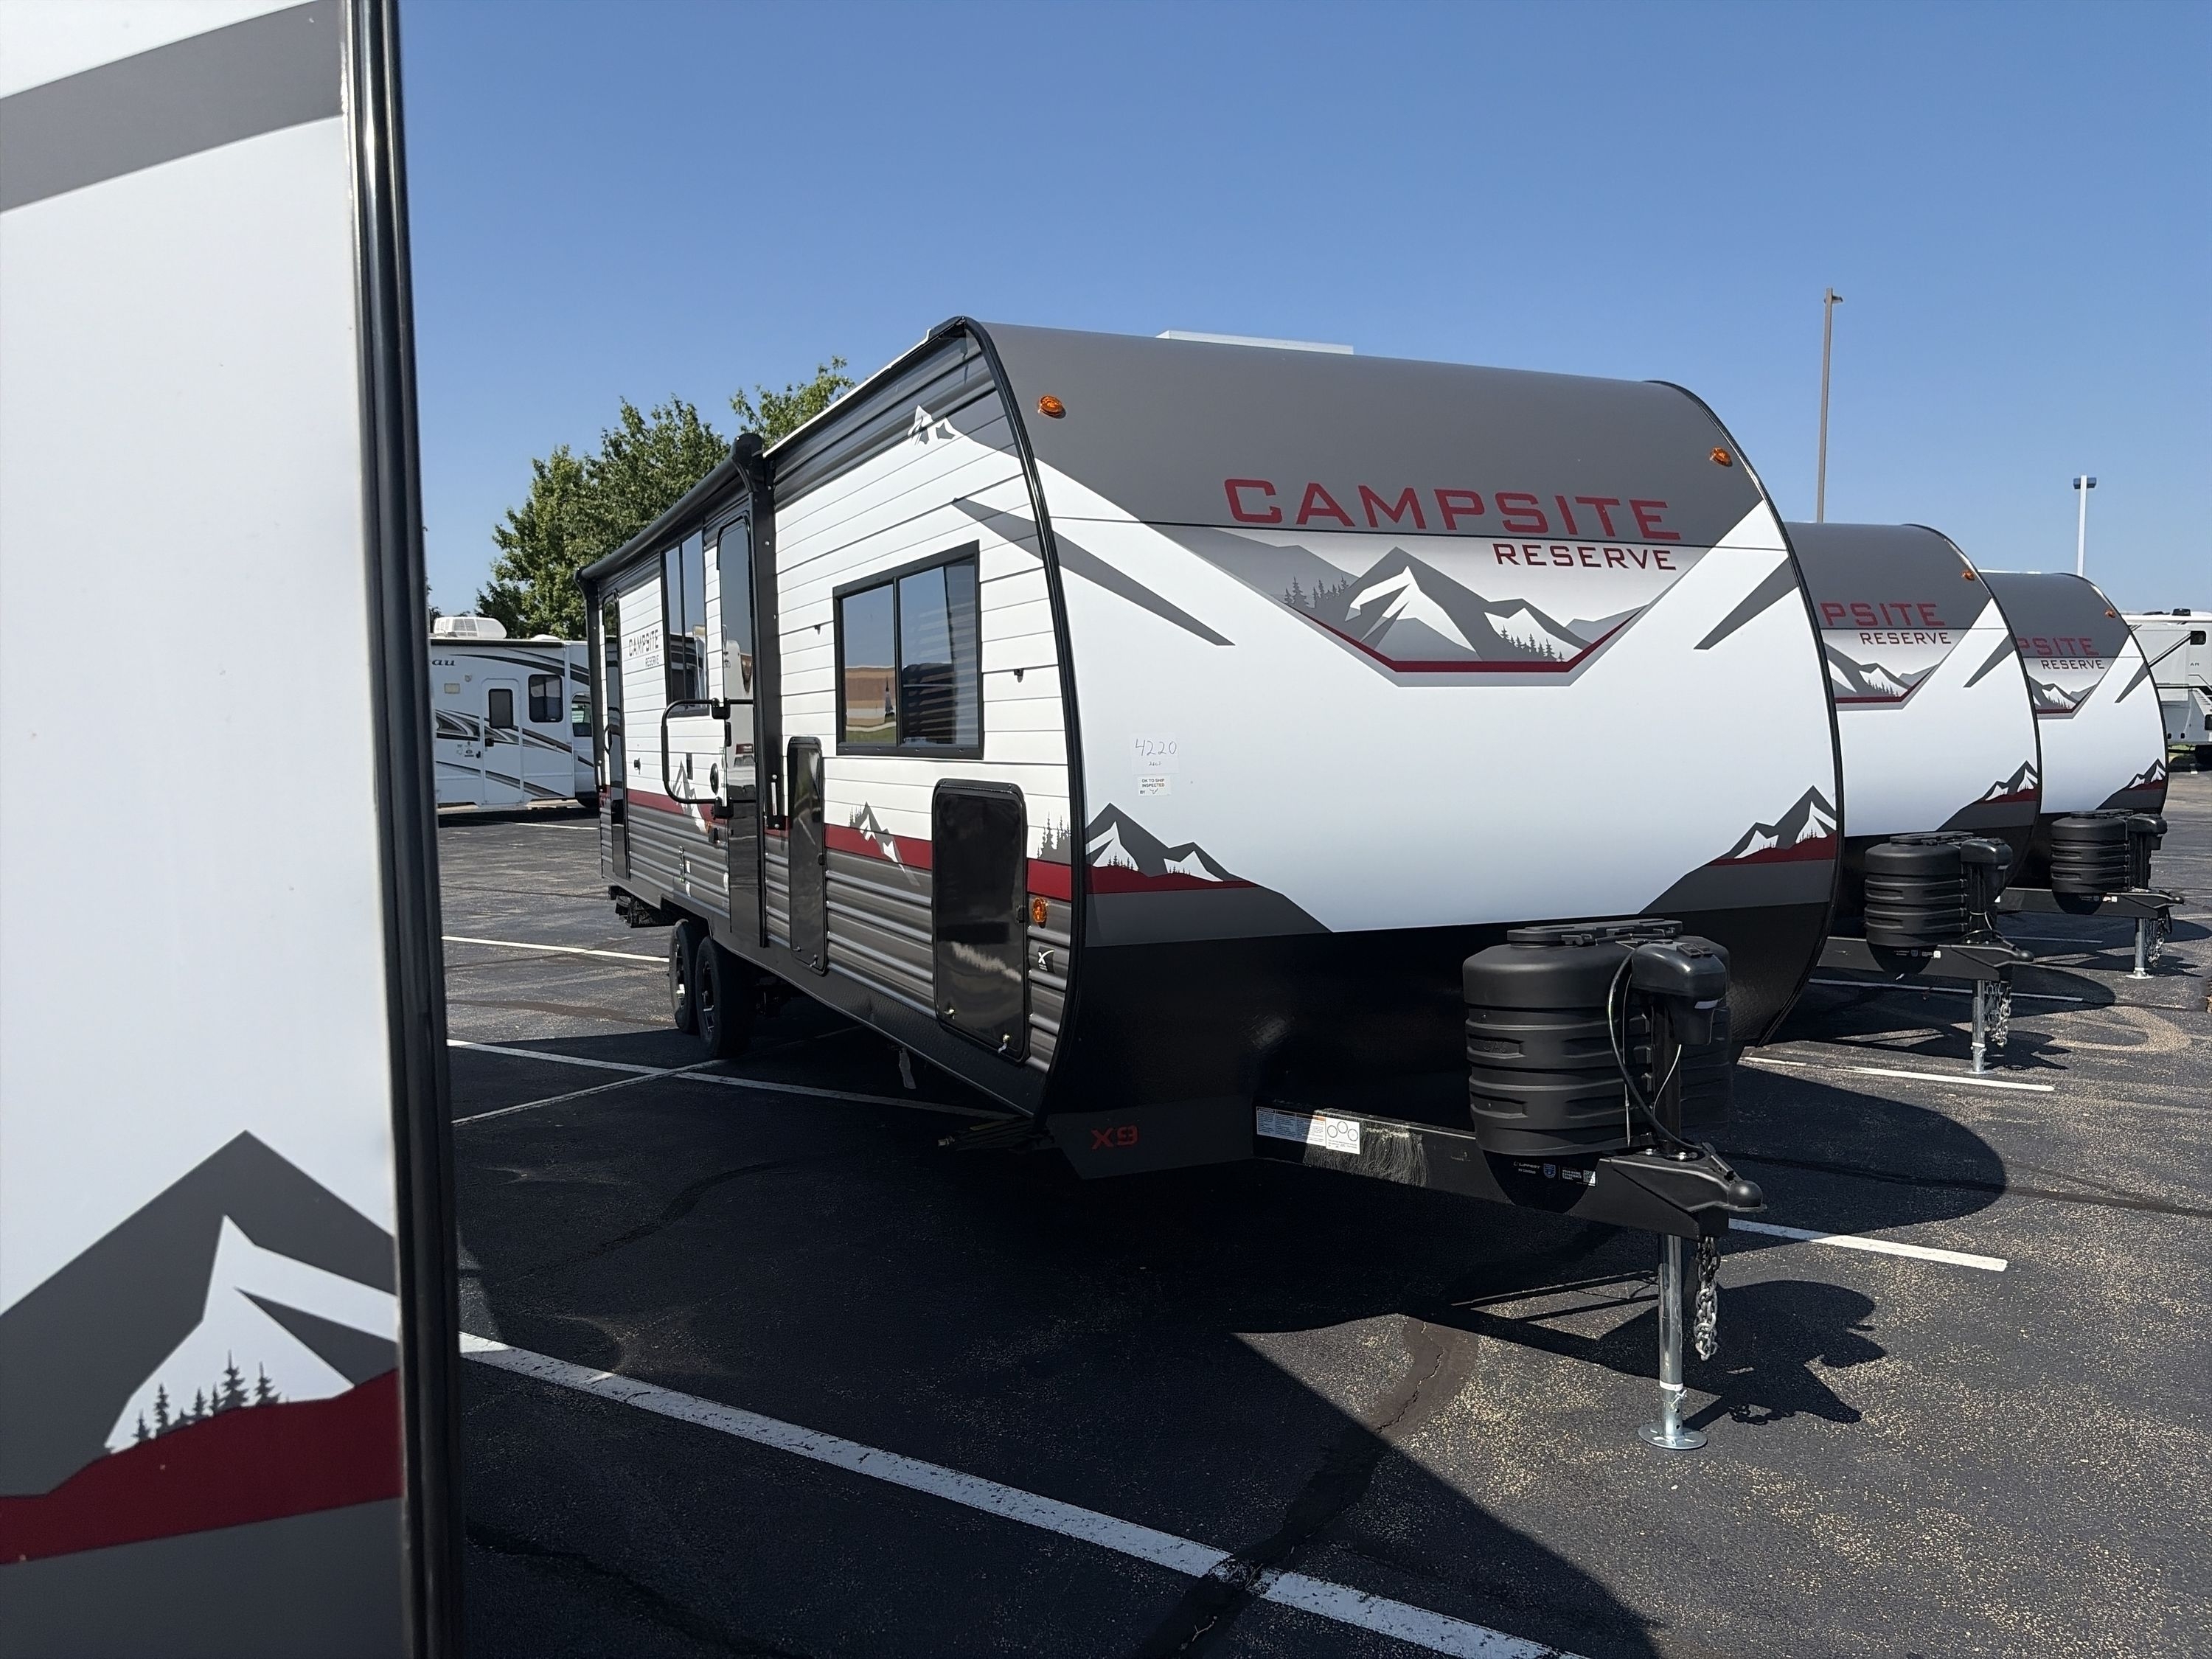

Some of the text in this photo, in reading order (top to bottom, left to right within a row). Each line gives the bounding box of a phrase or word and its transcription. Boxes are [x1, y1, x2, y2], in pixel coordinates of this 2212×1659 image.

[1224, 479, 1680, 540] CAMPSITE
[1493, 543, 1677, 571] RESERVE
[1820, 602, 1946, 627] PSITE
[629, 629, 659, 657] CAMPSITE
[1860, 632, 1952, 645] RESERVE
[2040, 659, 2105, 670] RESERVE
[1135, 738, 1178, 757] 4220
[1091, 1124, 1139, 1150] X9
